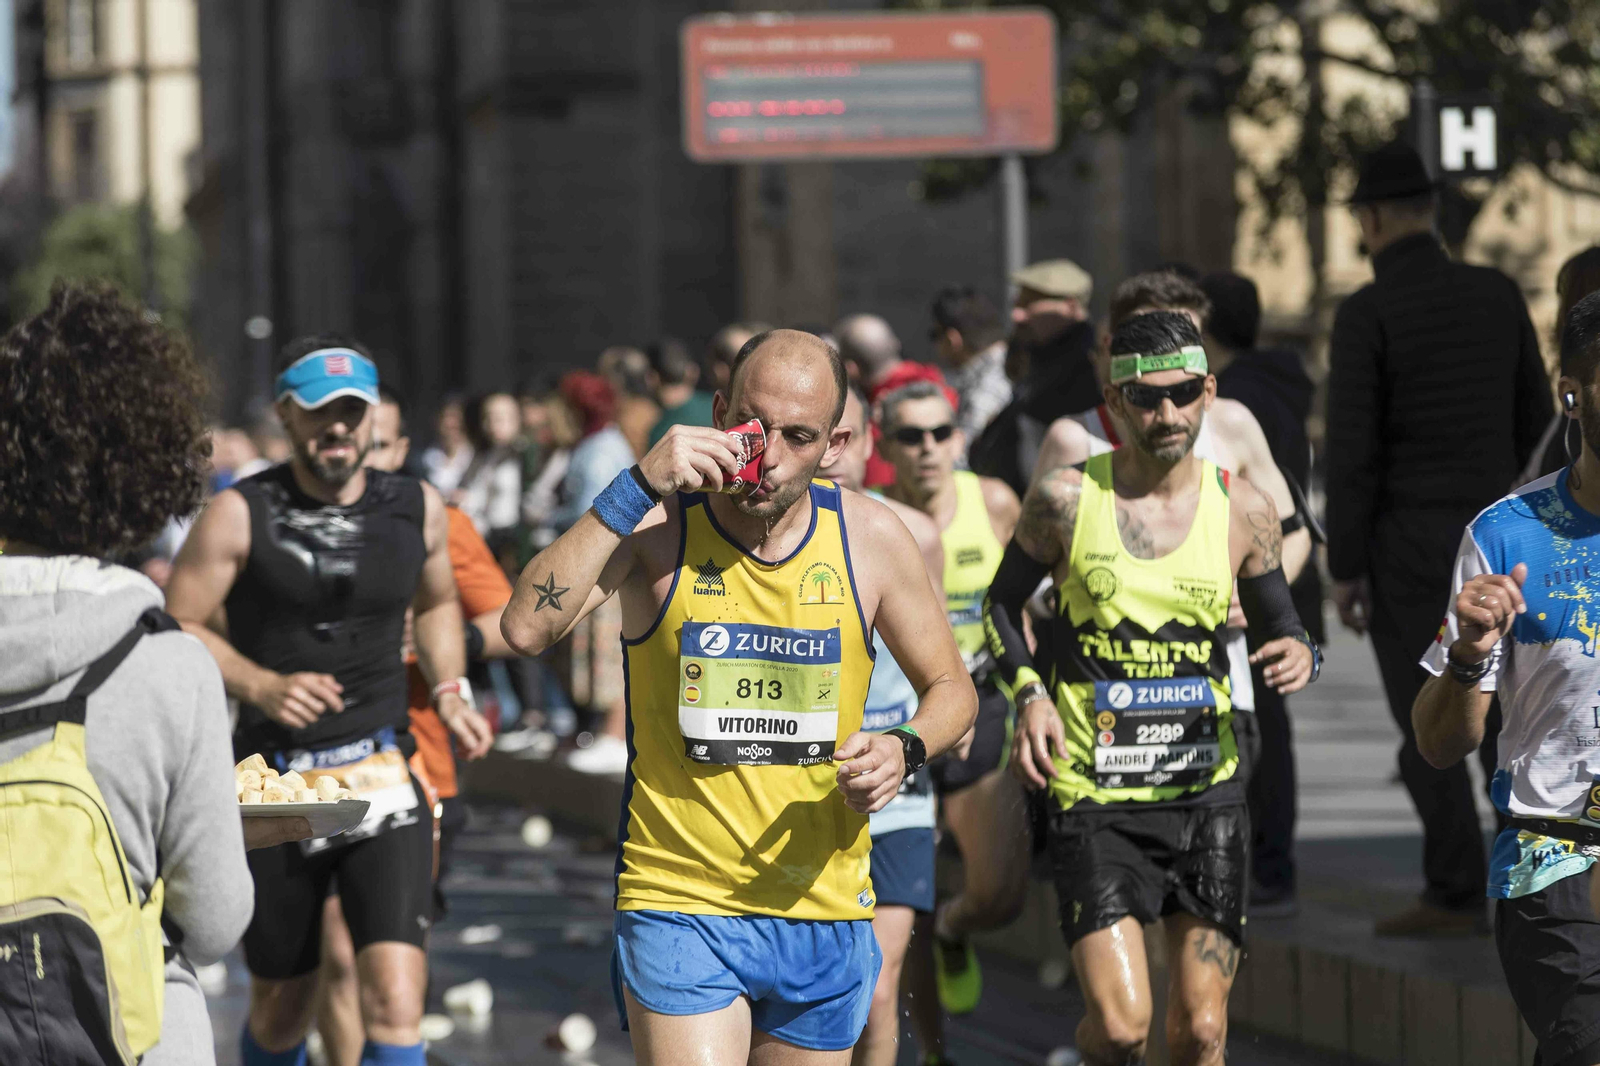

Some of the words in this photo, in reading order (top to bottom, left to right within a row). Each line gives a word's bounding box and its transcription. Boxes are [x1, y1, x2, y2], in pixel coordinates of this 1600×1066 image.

[1440, 106, 1497, 171] H
[801, 561, 823, 583] ATLETISMO
[823, 562, 838, 576] PALMA
[1544, 565, 1591, 588] GOBIK
[693, 583, 726, 597] luanvi
[735, 632, 826, 657] ZURICH
[766, 664, 786, 672] SEVILLA
[1122, 662, 1175, 678] TEAM
[736, 678, 783, 700] 813
[1136, 684, 1204, 704] ZURICH
[718, 717, 798, 736] VITORINO
[798, 755, 831, 765] ZURICH
[1104, 751, 1150, 768] ANDRÉ
